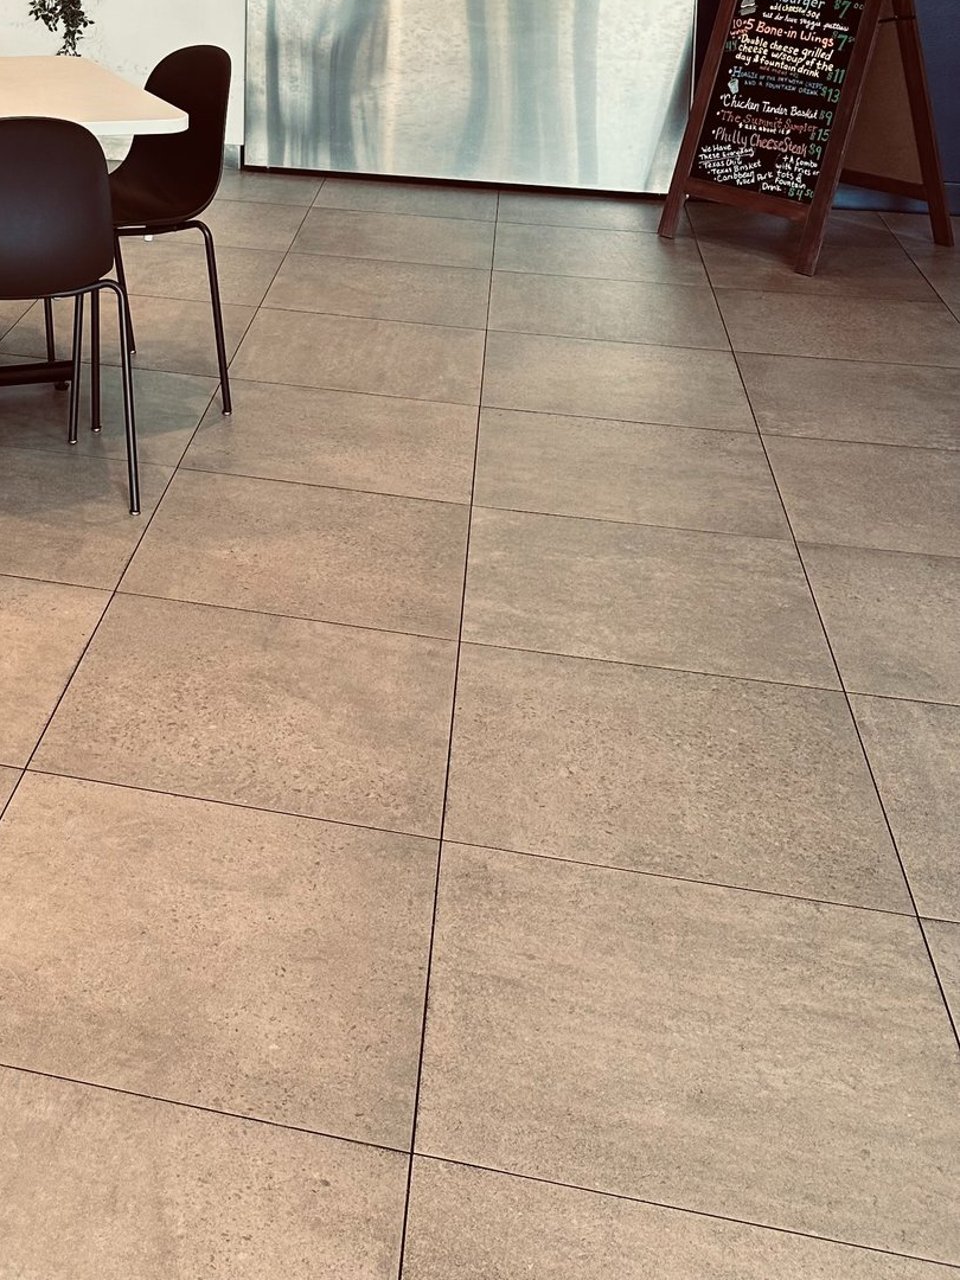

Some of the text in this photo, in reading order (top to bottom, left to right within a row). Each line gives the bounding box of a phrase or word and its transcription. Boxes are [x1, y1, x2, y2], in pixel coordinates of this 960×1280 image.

[741, 34, 768, 47] Double
[770, 41, 799, 55] cheese
[802, 47, 834, 60] grilled
[756, 21, 834, 48] Bone-in Wings
[735, 53, 751, 65] day
[760, 56, 796, 72] fountain
[798, 67, 819, 78] drink
[738, 44, 768, 55] cheese
[806, 58, 814, 67] of
[816, 59, 834, 72] the
[723, 94, 818, 119] Chicken Tender Basket
[721, 110, 741, 123] The
[743, 114, 782, 129] Summit
[715, 127, 748, 148] Philly
